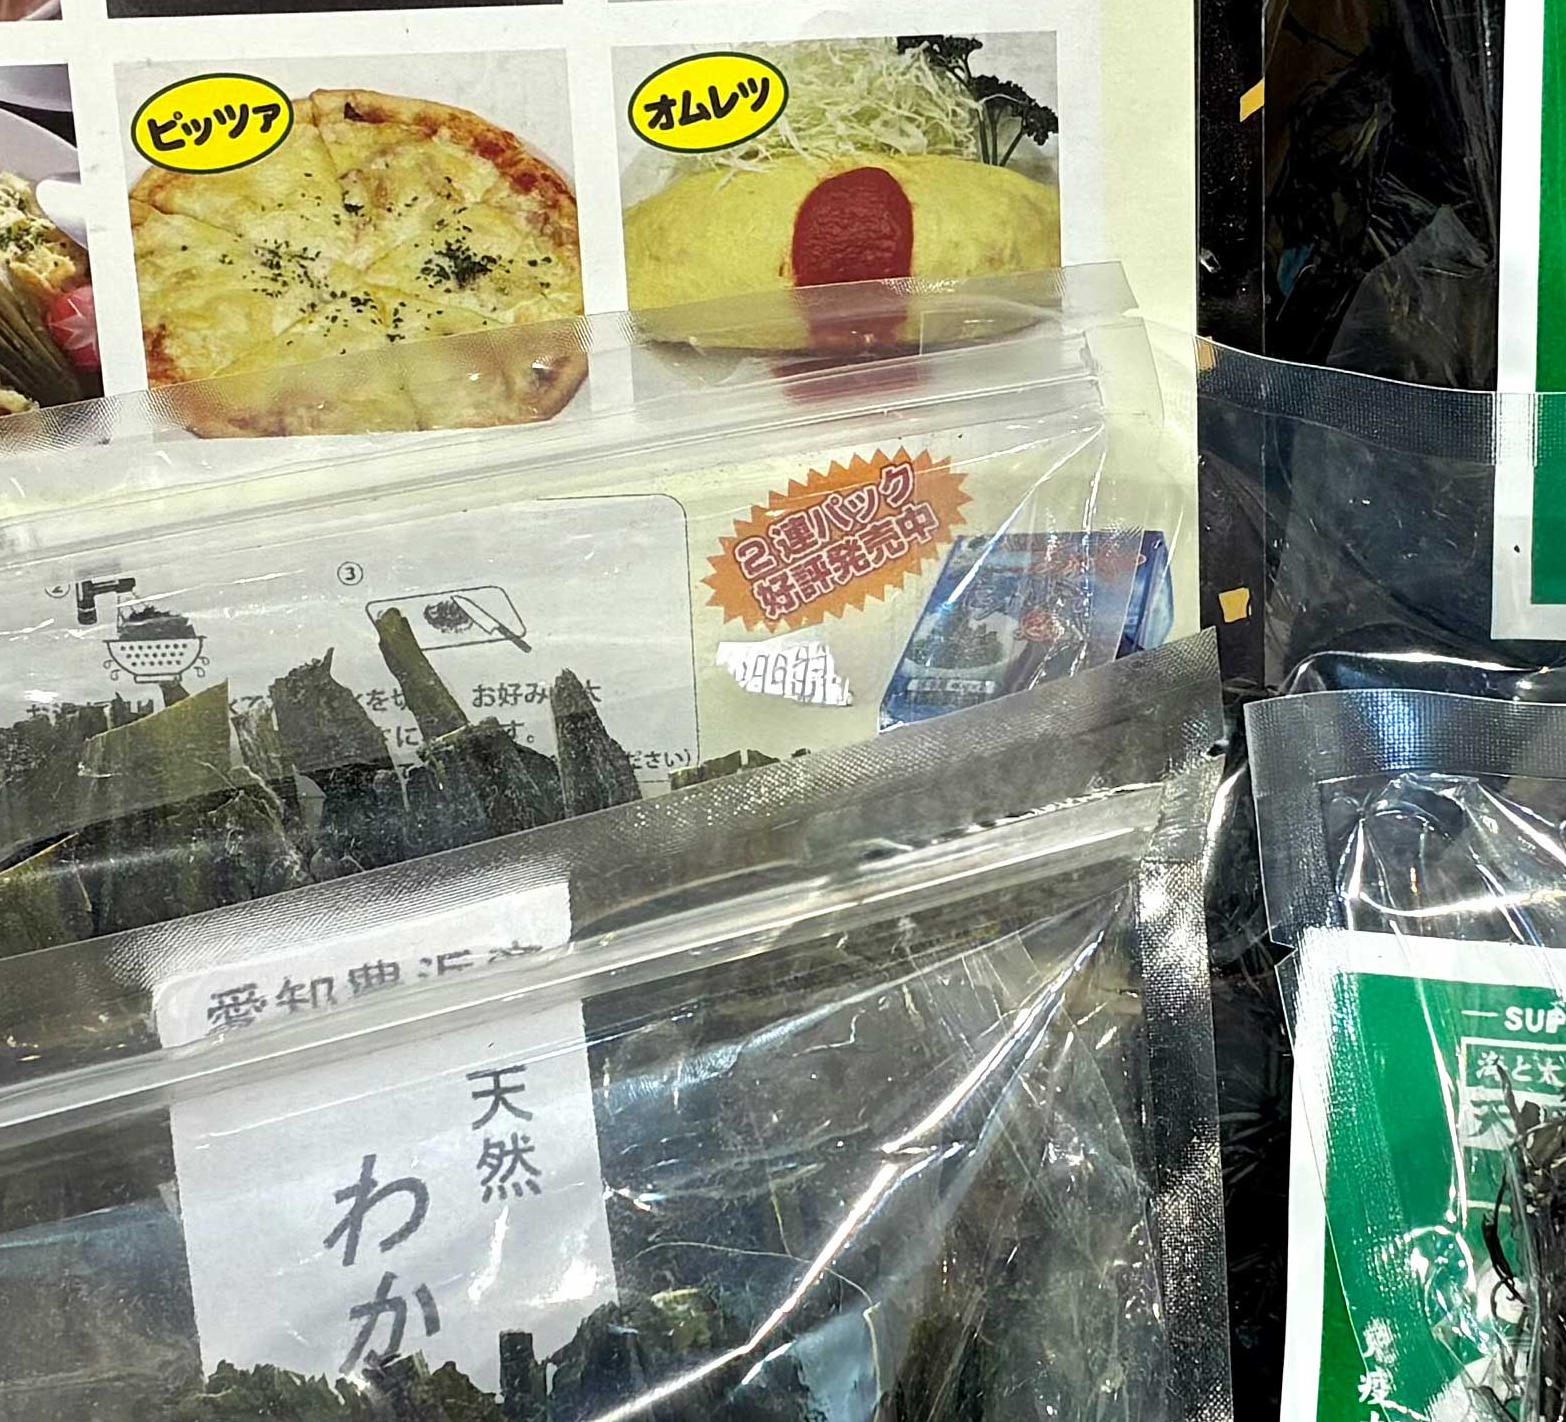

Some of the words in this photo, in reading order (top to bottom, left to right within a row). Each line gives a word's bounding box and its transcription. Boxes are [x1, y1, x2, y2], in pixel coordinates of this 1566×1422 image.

[147, 99, 280, 153] ピッツァ
[645, 77, 770, 131] オムレツ
[734, 462, 917, 578] 2連パック
[752, 502, 940, 620] 好評発売中
[466, 1063, 543, 1205] 天然
[323, 1152, 443, 1377] わか
